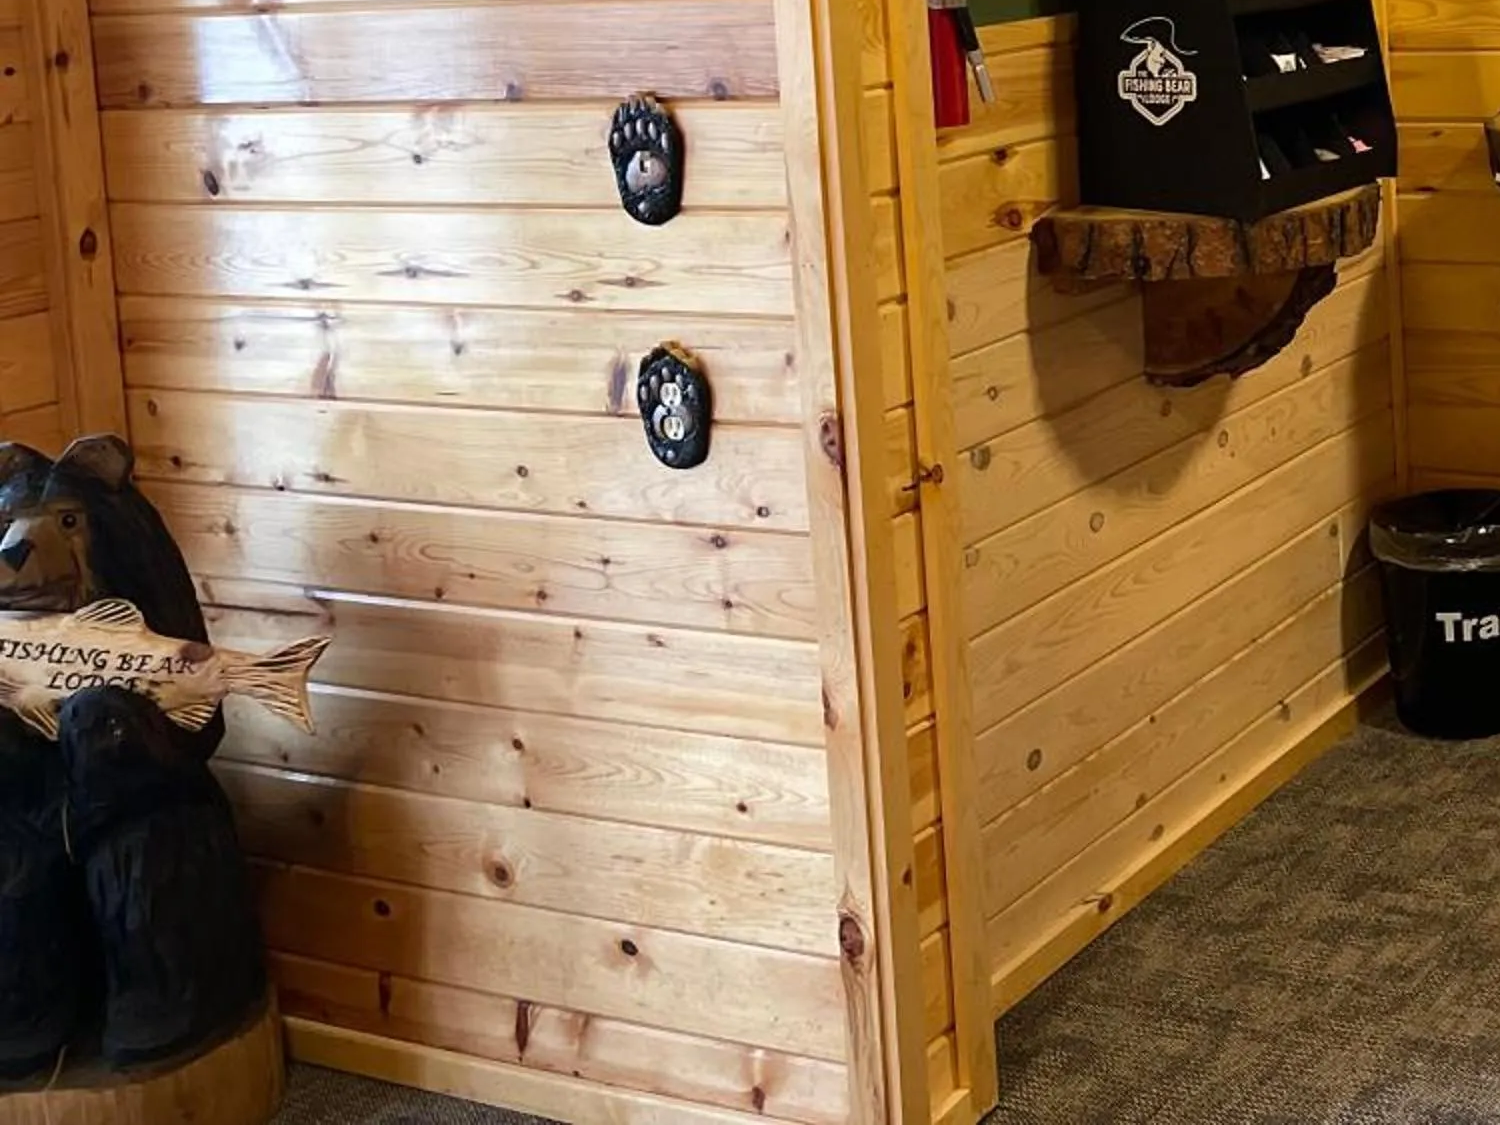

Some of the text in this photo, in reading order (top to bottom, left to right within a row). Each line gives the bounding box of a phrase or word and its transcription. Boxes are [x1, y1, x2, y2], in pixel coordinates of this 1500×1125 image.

[1126, 79, 1190, 93] FISHING BEAR
[116, 653, 196, 674] BEAR
